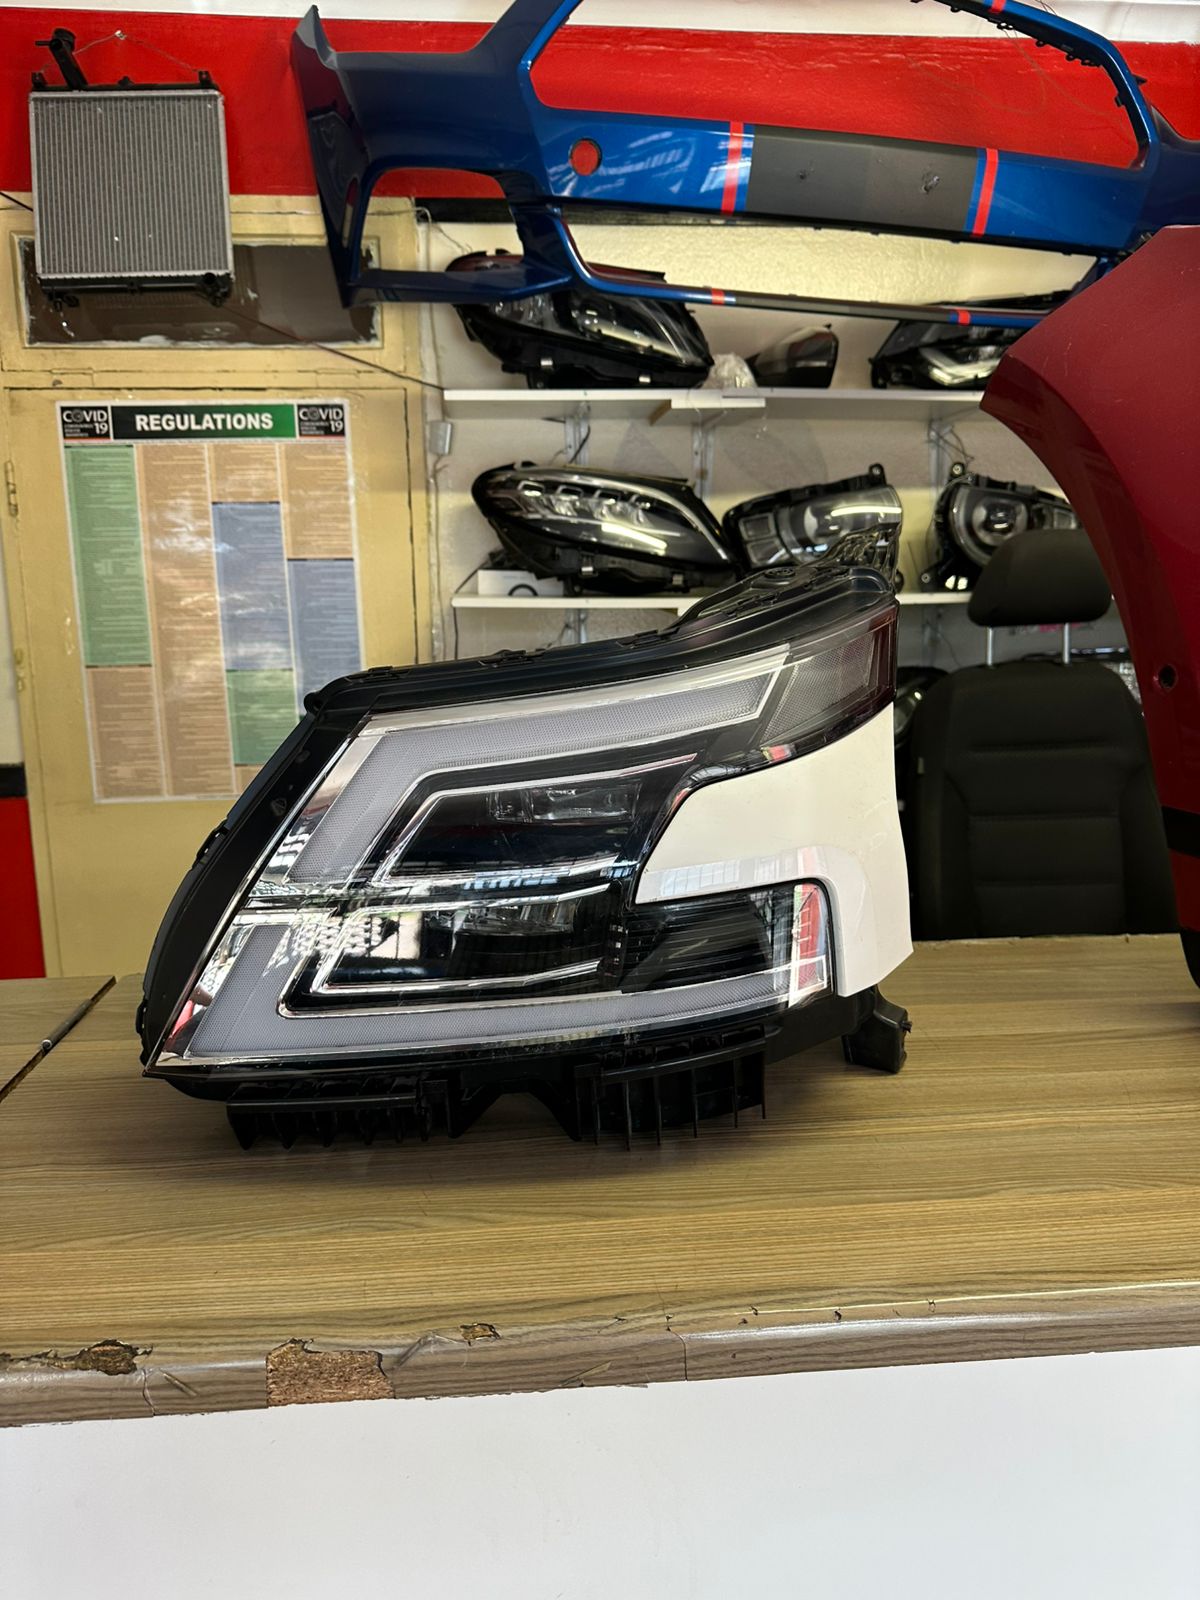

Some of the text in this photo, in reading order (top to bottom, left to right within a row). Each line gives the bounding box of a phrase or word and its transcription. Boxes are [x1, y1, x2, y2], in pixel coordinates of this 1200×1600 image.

[63, 410, 108, 422] COVID
[299, 407, 343, 420] COVID
[94, 422, 108, 434] 19
[135, 413, 273, 431] REGULATIONS
[330, 420, 344, 432] 19
